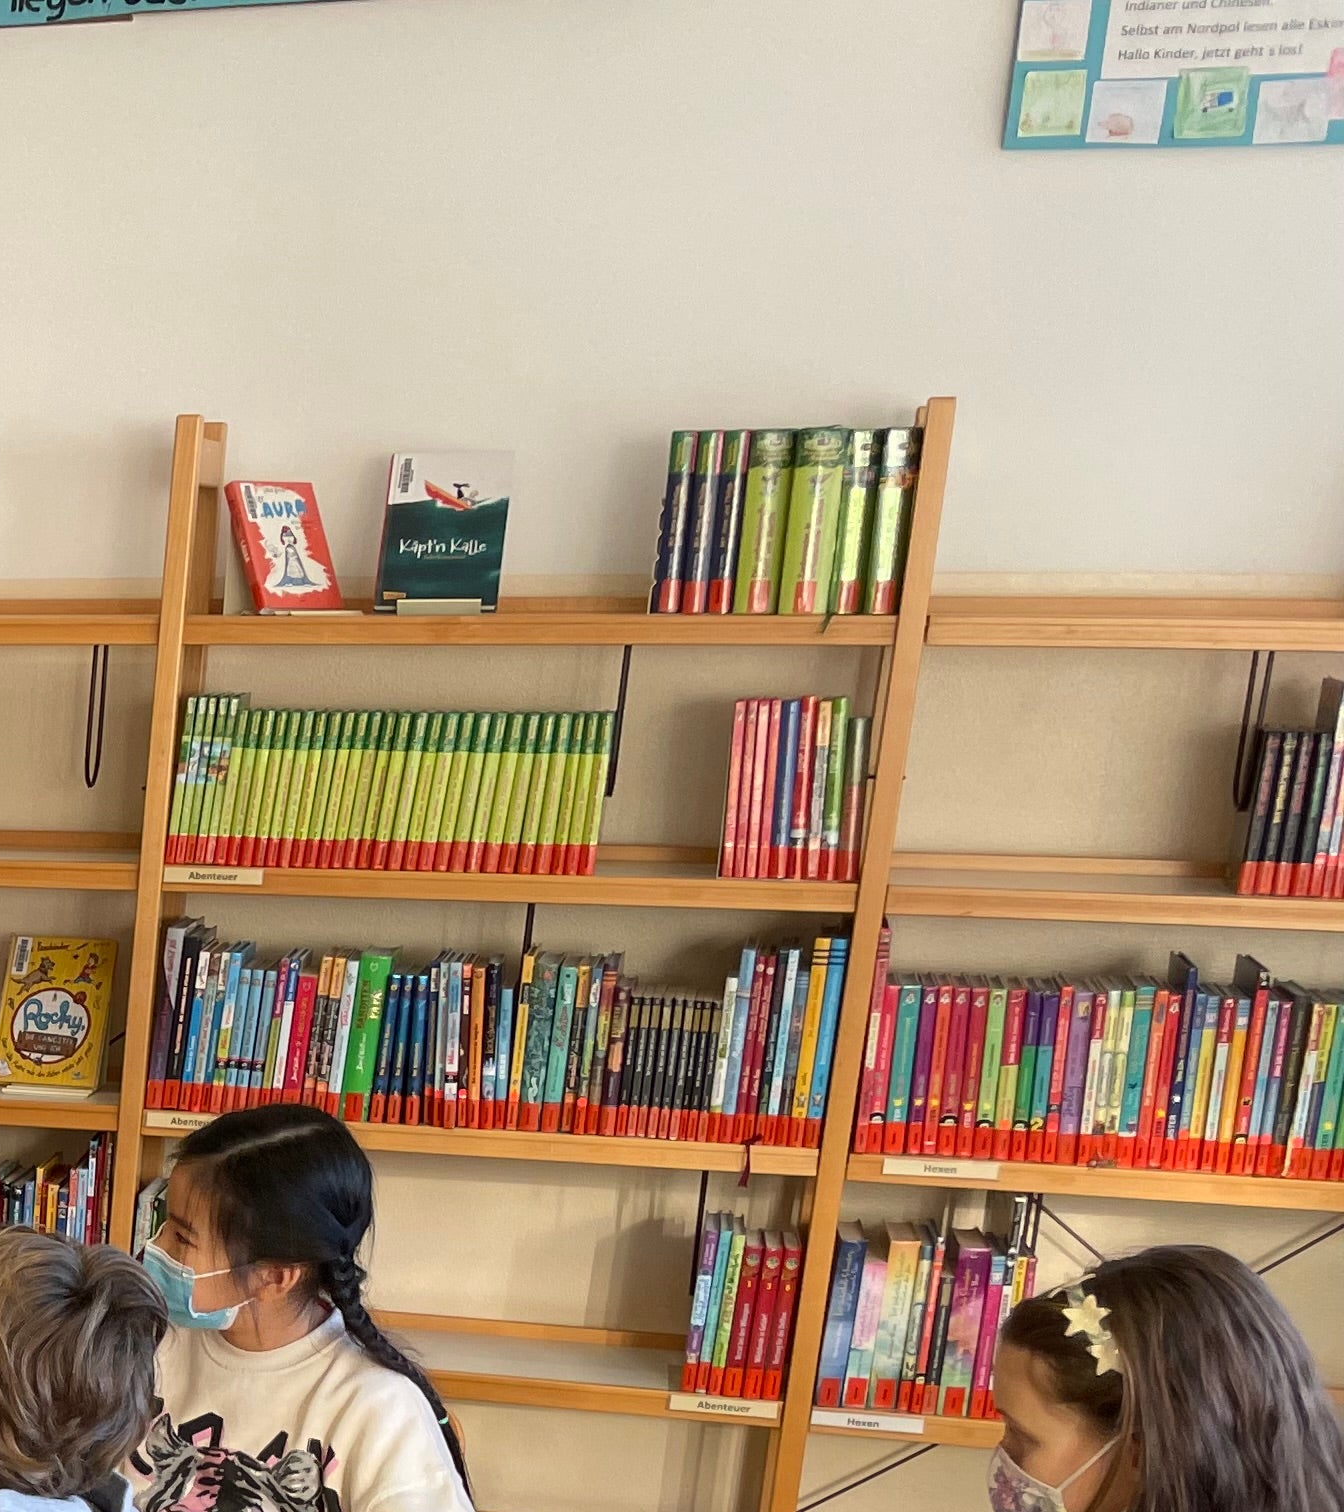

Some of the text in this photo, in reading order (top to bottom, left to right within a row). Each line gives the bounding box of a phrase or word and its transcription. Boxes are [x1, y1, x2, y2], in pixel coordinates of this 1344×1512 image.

[1121, 23, 1158, 36] Selbst
[1163, 26, 1182, 35] am
[1186, 20, 1240, 35] Nordpol
[1118, 48, 1150, 60] Hallo
[1154, 46, 1198, 60] Kinder,
[1202, 47, 1230, 60] jetzt
[1234, 46, 1263, 60] geht
[450, 536, 487, 556] Kalle
[187, 870, 238, 883] Abenteuer
[923, 1162, 958, 1175] Hexen
[696, 1399, 752, 1415] Abenteuer
[847, 1416, 880, 1430] Hexen
